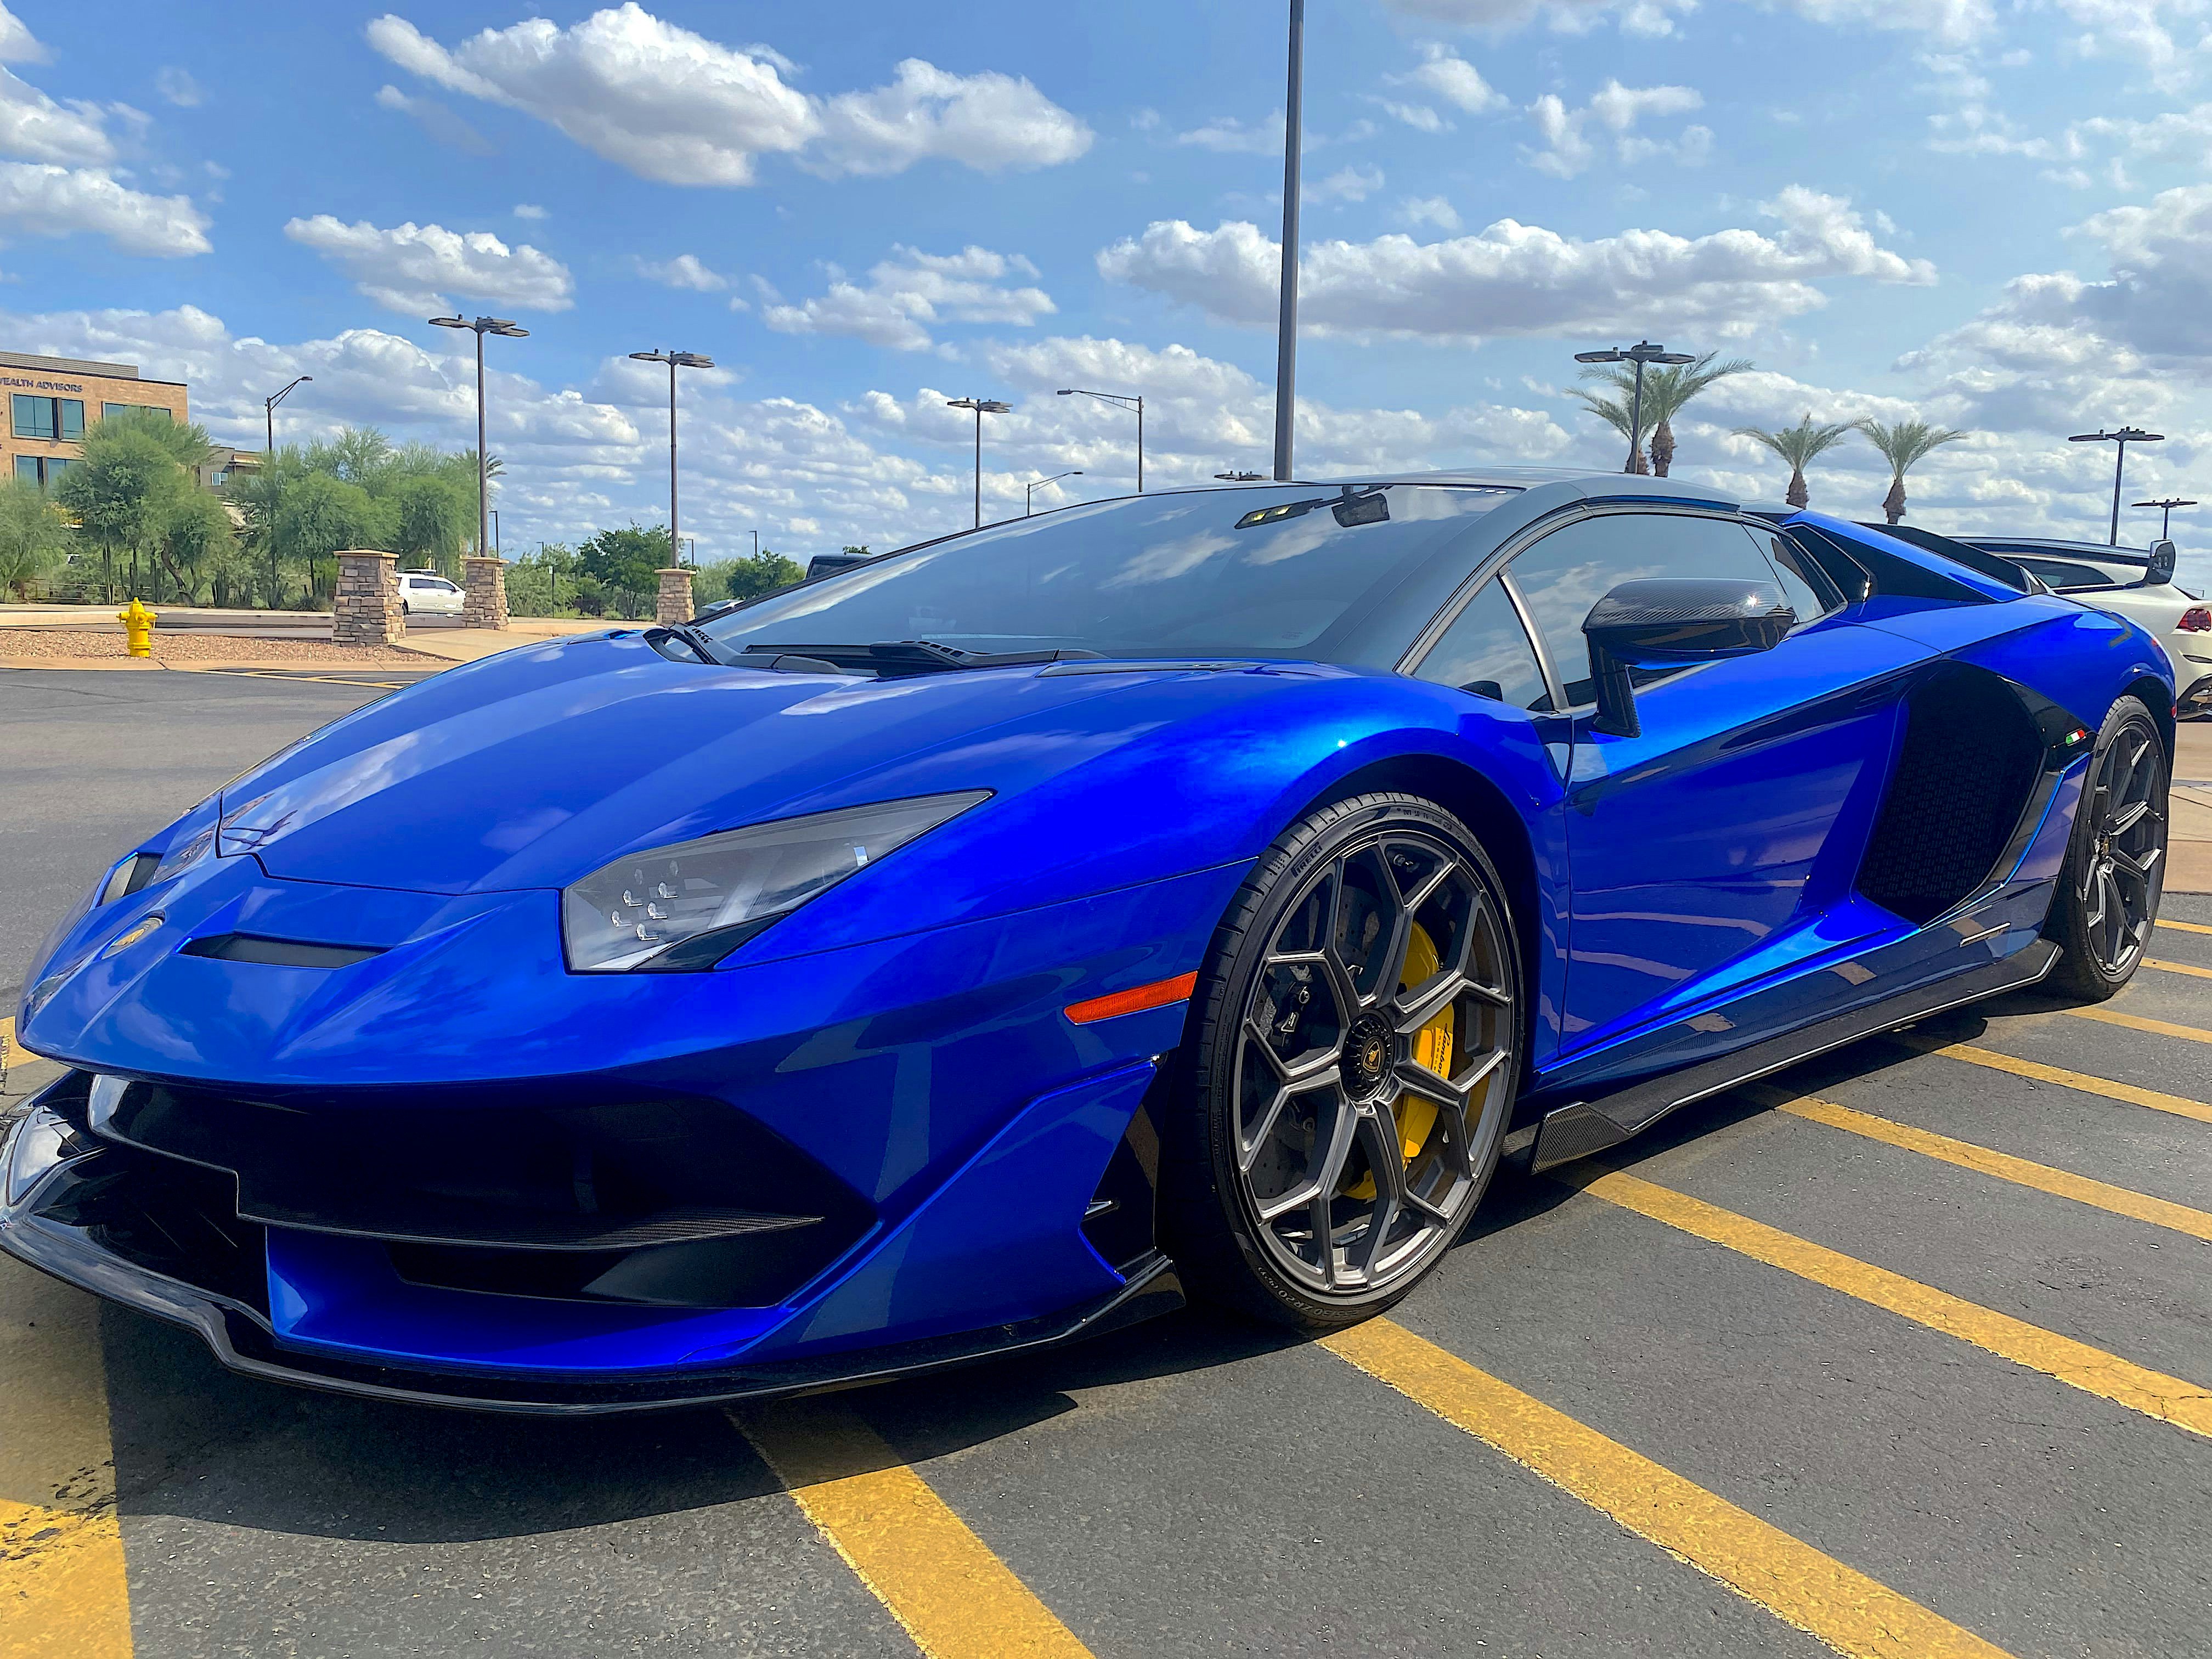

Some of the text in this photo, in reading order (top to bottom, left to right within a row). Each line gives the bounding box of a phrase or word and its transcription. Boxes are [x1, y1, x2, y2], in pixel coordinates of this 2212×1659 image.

[36, 381, 83, 392] ADVISORS
[1290, 841, 1323, 878] PIRELLI
[1437, 1023, 1450, 1075] Lambor
[1278, 1290, 1314, 1312] ZR20
